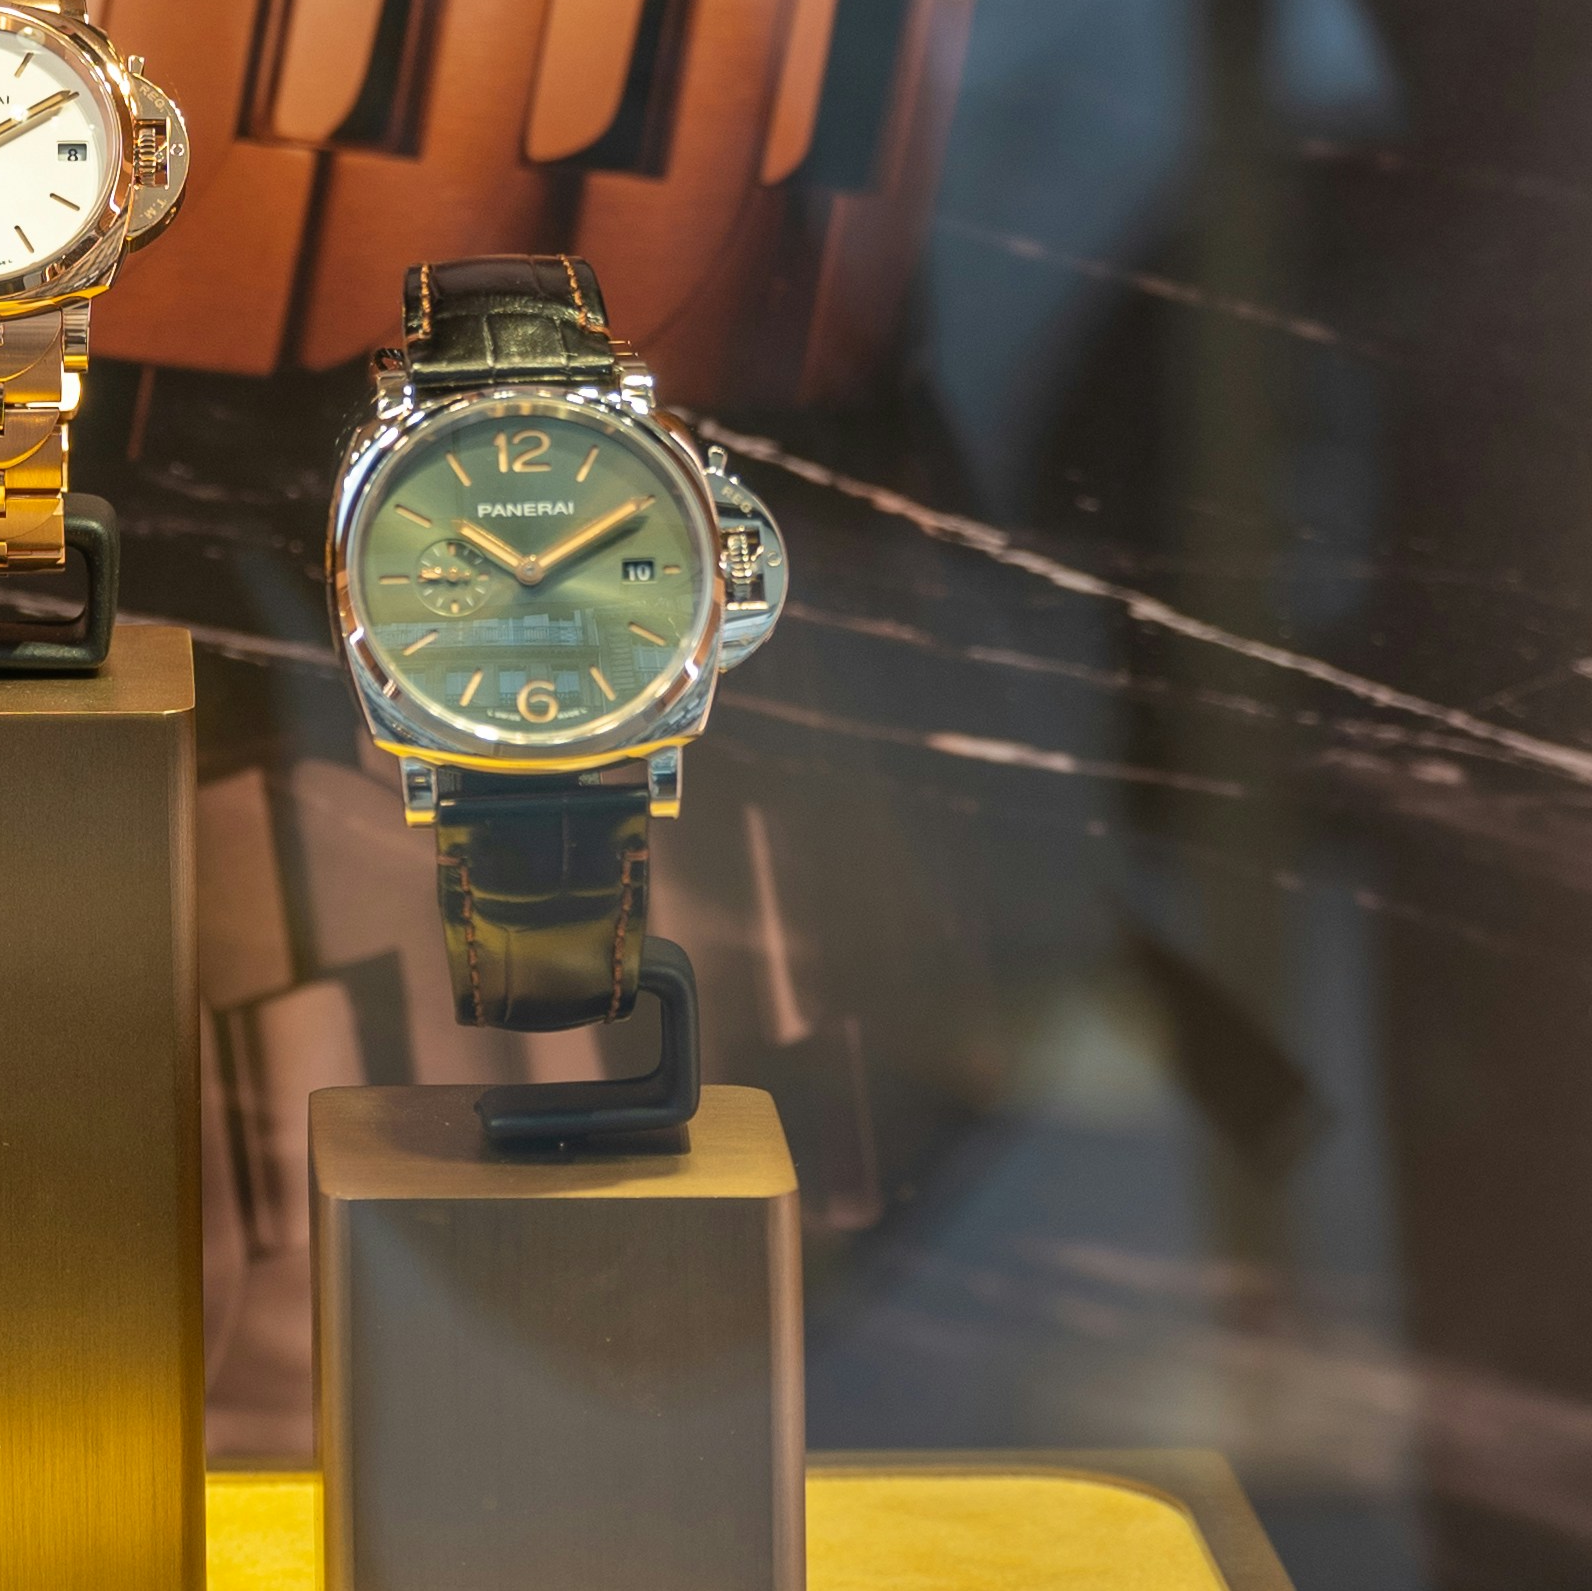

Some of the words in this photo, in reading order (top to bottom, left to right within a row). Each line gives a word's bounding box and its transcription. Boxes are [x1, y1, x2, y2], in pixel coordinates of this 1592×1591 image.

[494, 429, 551, 473] 12
[477, 501, 575, 519] PANERAI
[625, 563, 651, 582] 10
[516, 680, 559, 724] 6
